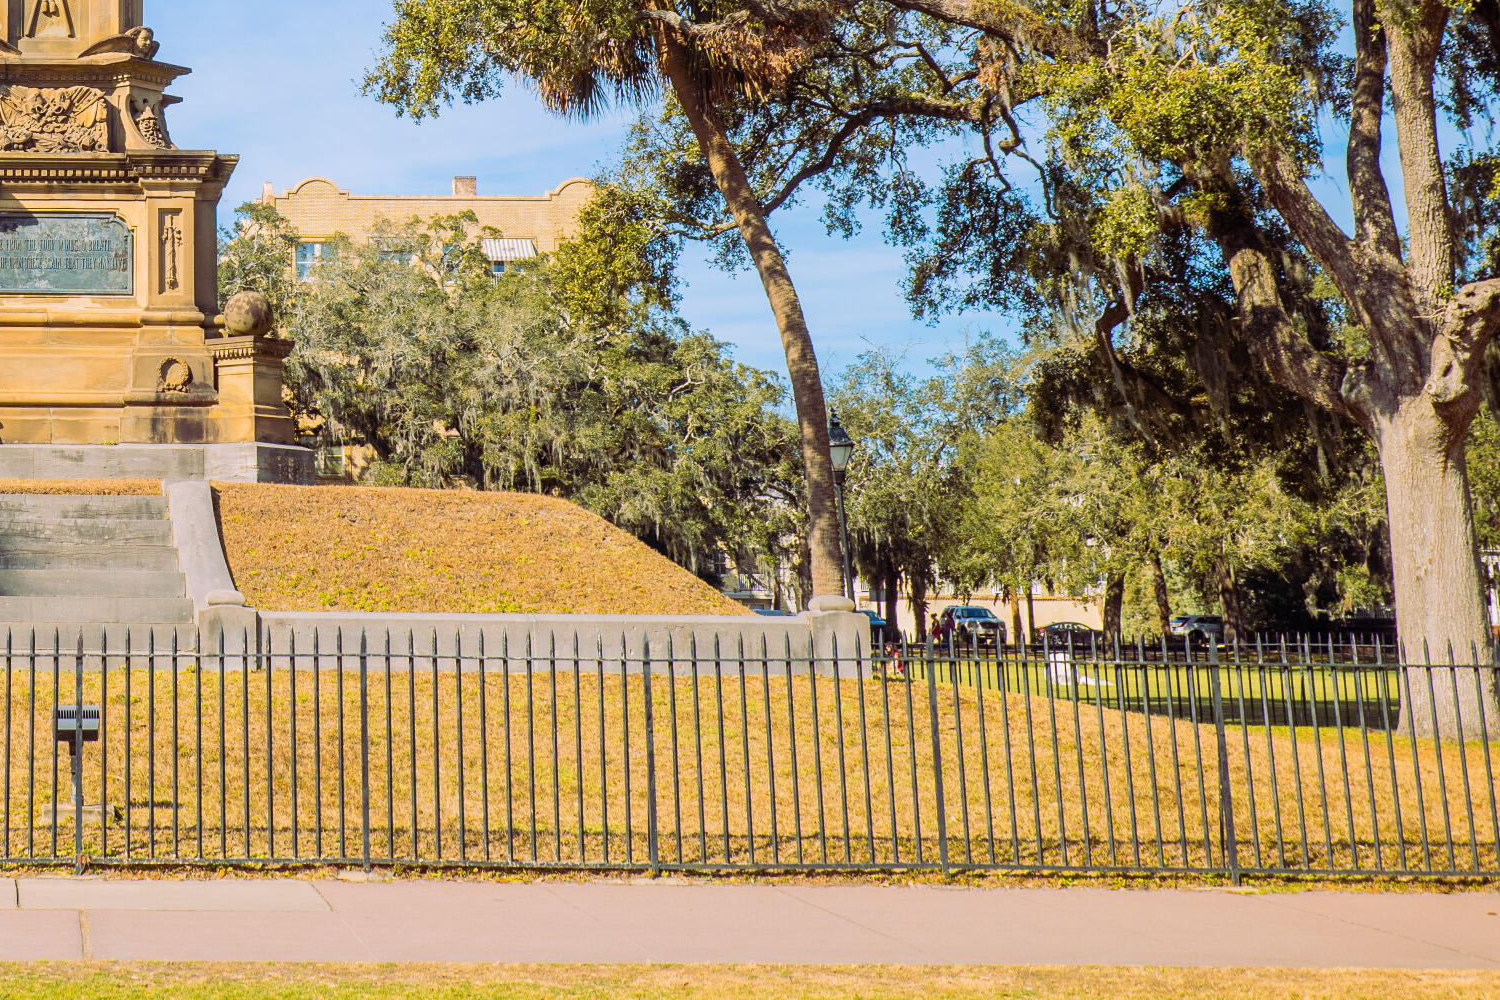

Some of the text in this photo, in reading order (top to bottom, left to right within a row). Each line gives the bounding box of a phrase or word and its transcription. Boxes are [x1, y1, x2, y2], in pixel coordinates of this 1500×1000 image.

[6, 239, 21, 251] FROM
[25, 239, 37, 251] THE
[82, 257, 97, 269] THEY
